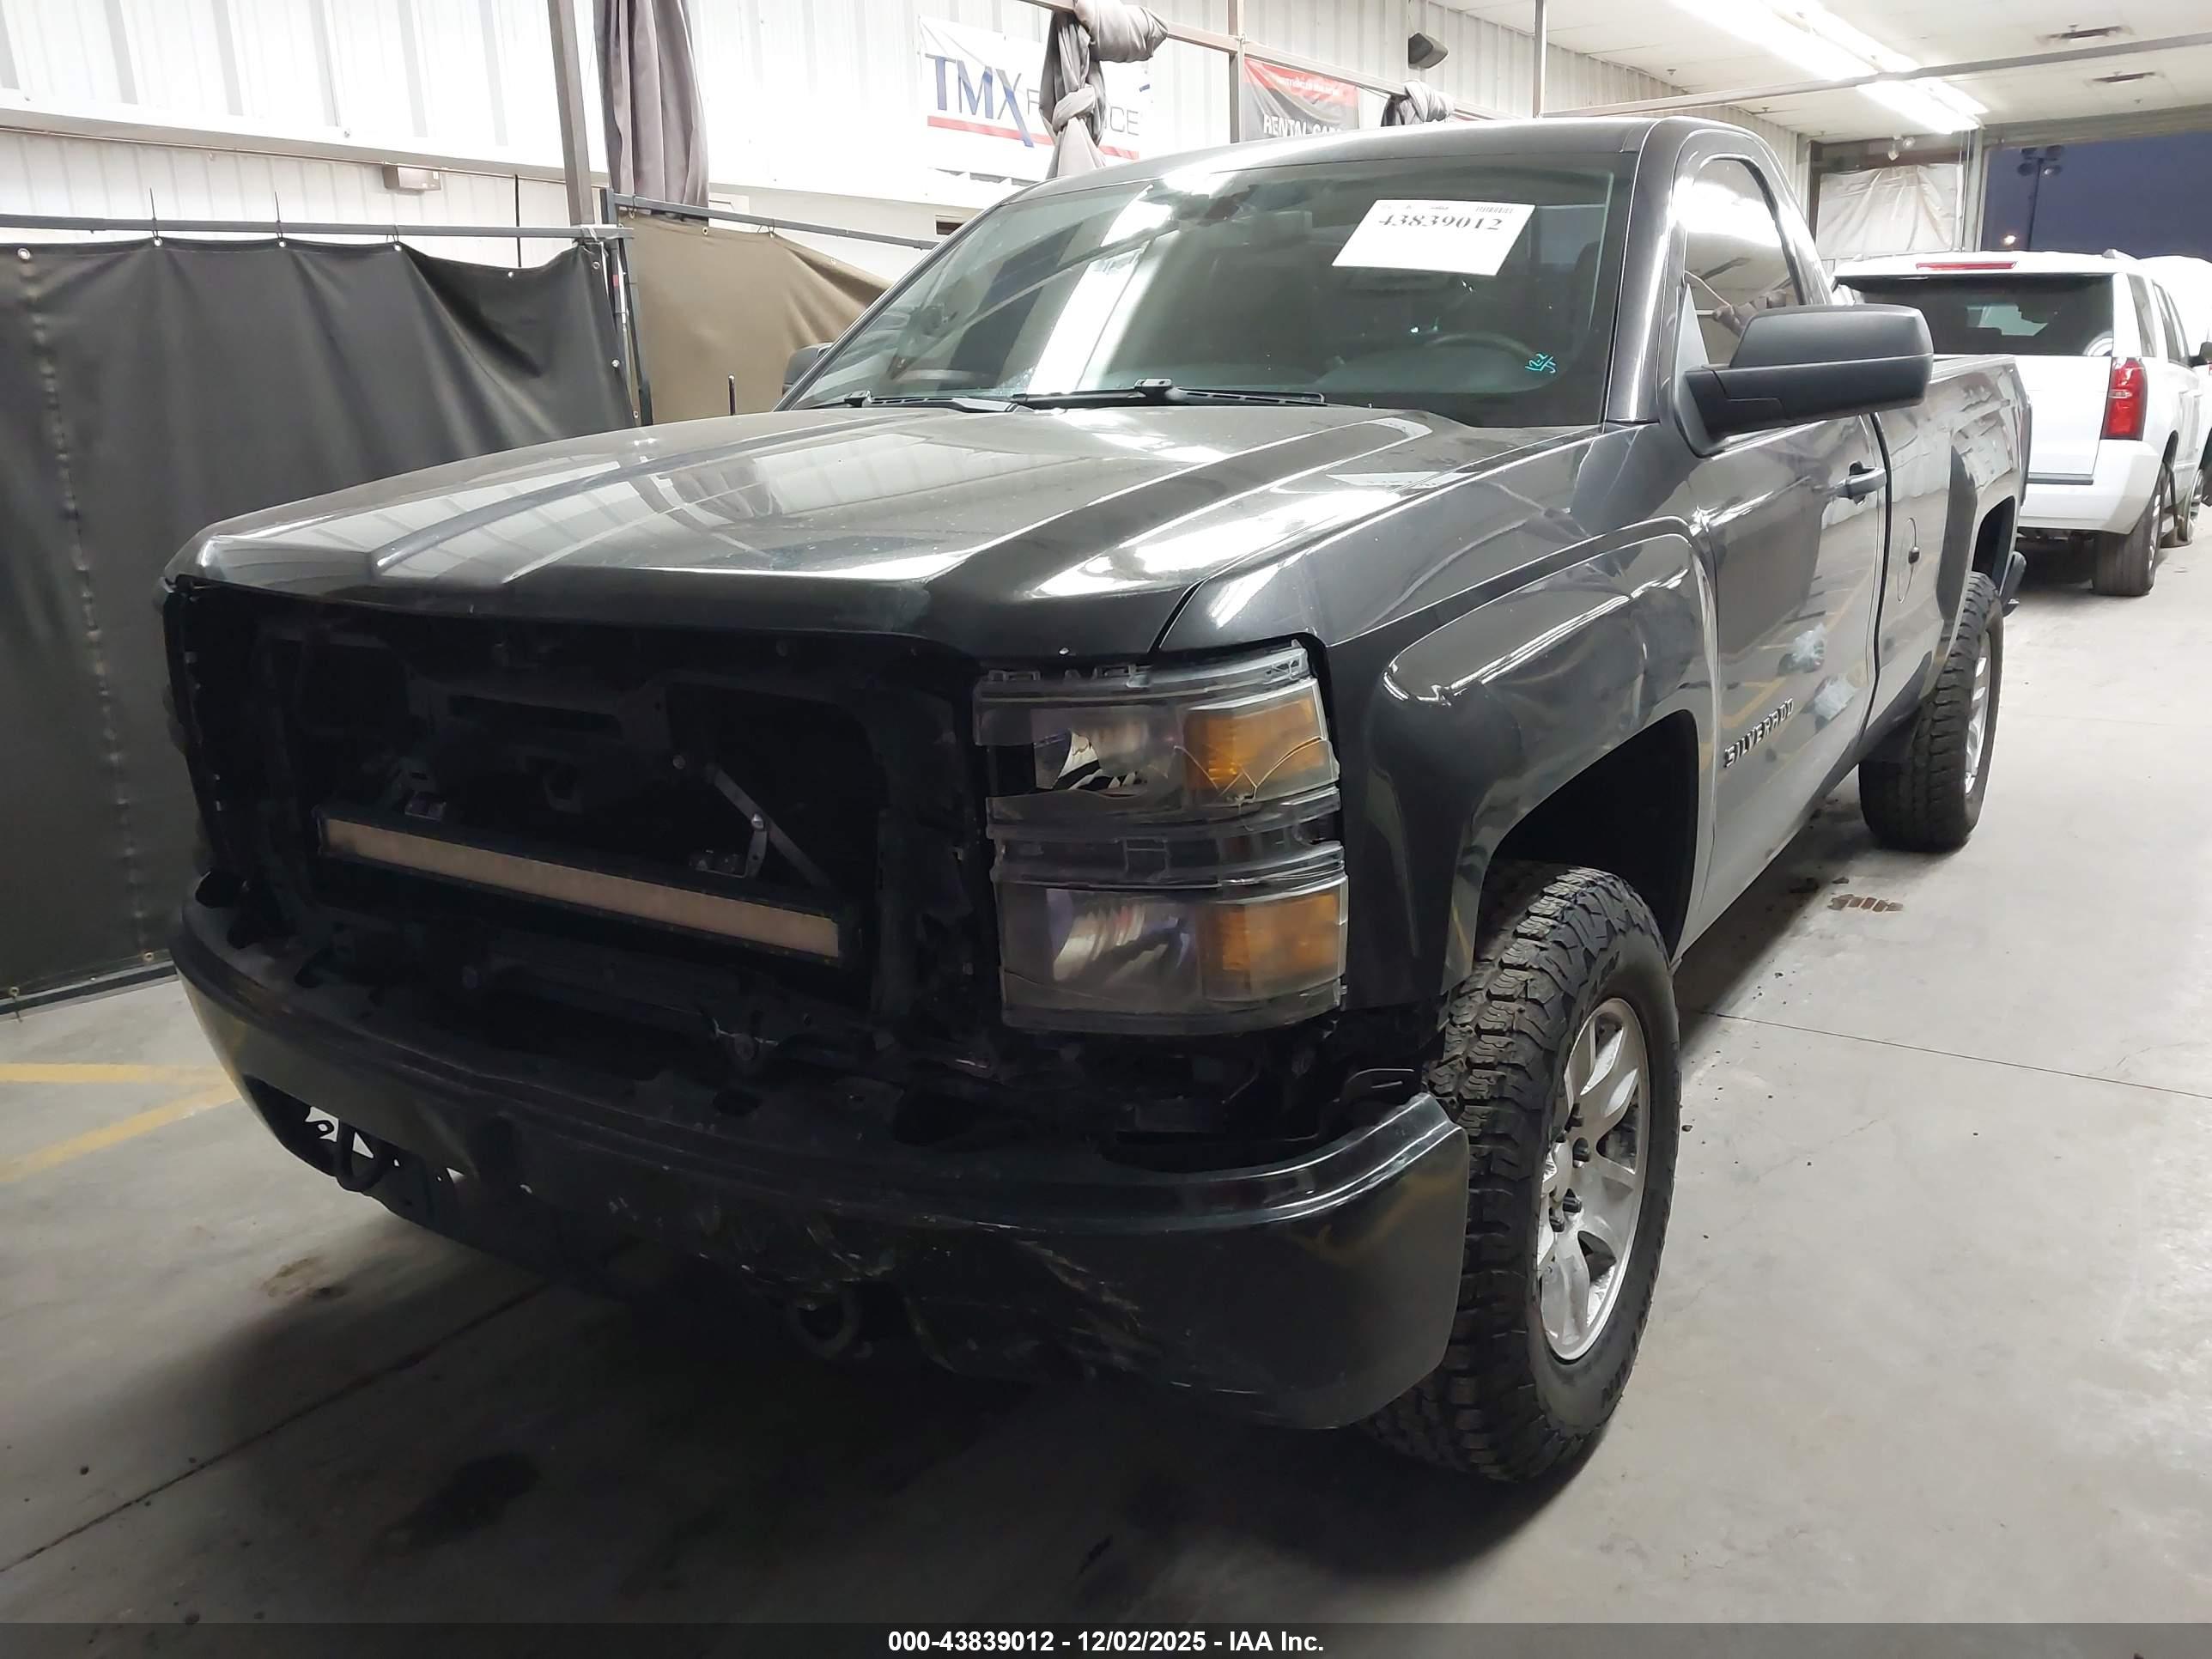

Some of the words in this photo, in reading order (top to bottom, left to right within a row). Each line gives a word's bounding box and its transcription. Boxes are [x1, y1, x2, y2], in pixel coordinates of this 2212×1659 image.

[925, 52, 1035, 148] TMX
[1378, 214, 1503, 231] 43839012
[1723, 697, 1794, 768] SILVERADO
